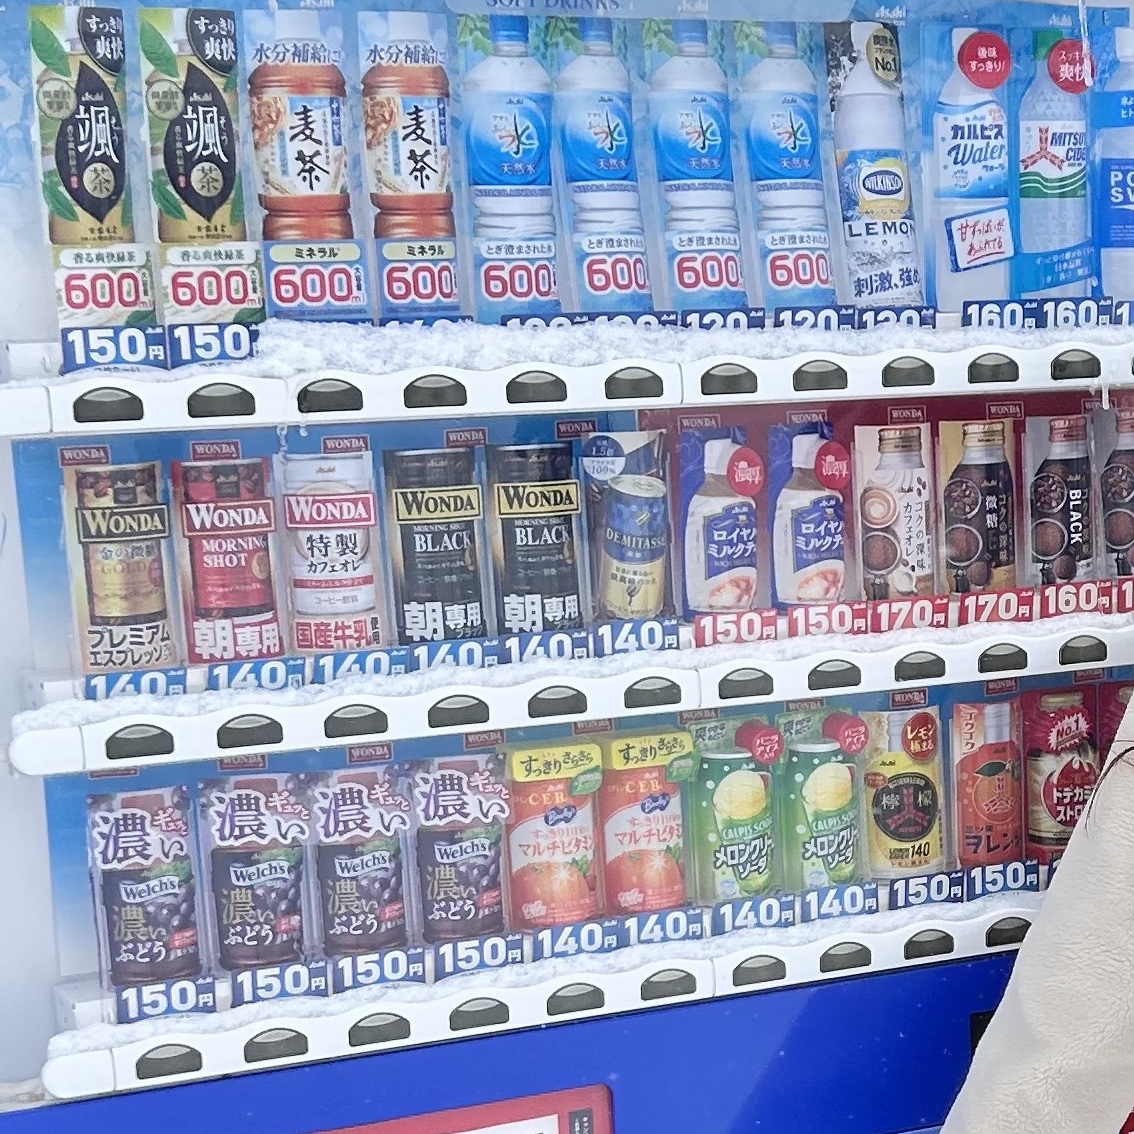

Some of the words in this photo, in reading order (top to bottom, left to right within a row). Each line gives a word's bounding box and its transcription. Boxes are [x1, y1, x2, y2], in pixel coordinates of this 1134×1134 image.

[86, 14, 123, 34] すっきり
[193, 16, 235, 35] すっきり
[94, 36, 124, 60] 爽快
[204, 37, 236, 61] 爽快
[289, 104, 331, 191] 麦茶
[401, 104, 439, 190] 麦茶
[88, 166, 111, 195] 茶
[196, 165, 221, 194] 茶
[448, 430, 485, 443] WONDA
[559, 421, 594, 434] WONDA
[62, 448, 107, 461] WONDA
[193, 442, 237, 456] WONDA
[324, 436, 366, 450] WONDA
[289, 495, 369, 523] WONDA
[400, 489, 476, 516] WONDA
[501, 484, 575, 510] WONDA
[81, 508, 165, 537] WONDA
[187, 501, 270, 532] WONDA
[1069, 488, 1083, 546] BLACK
[305, 532, 360, 558] 特製
[413, 529, 473, 553] BLACK
[514, 523, 572, 547] BLACK
[202, 552, 249, 569] SHOT
[403, 600, 482, 642] 朝専用
[503, 593, 579, 633] 朝専用
[792, 603, 867, 637] 150円
[875, 598, 946, 634] 170円
[964, 591, 1030, 625] 170円
[87, 622, 171, 651] プレミアム
[192, 617, 281, 660] 朝専用
[295, 616, 373, 650] 国産牛乳
[597, 619, 679, 656] 140円
[906, 723, 936, 741] レモン
[319, 785, 407, 839] 濃い
[419, 773, 507, 822] 濃い
[212, 791, 307, 843] 濃い
[100, 811, 185, 866] 濃い
[437, 839, 487, 861] Welch's
[233, 859, 287, 883] Welch's
[338, 854, 388, 875] Welch's
[970, 861, 1038, 895] 150円
[123, 877, 178, 900] Welch's
[806, 883, 878, 921] 140円
[893, 874, 962, 905] 150円
[427, 898, 475, 921] ぶどう
[719, 896, 795, 933] 140円
[223, 924, 275, 947] ぶどう
[328, 914, 379, 935] ぶどう
[625, 909, 701, 946] 140円
[115, 940, 168, 964] ぶどう
[439, 935, 523, 974] 150円
[537, 922, 618, 958] 140円
[236, 963, 326, 1003] 150円
[337, 949, 424, 988] 150円
[121, 978, 214, 1020] 150円
